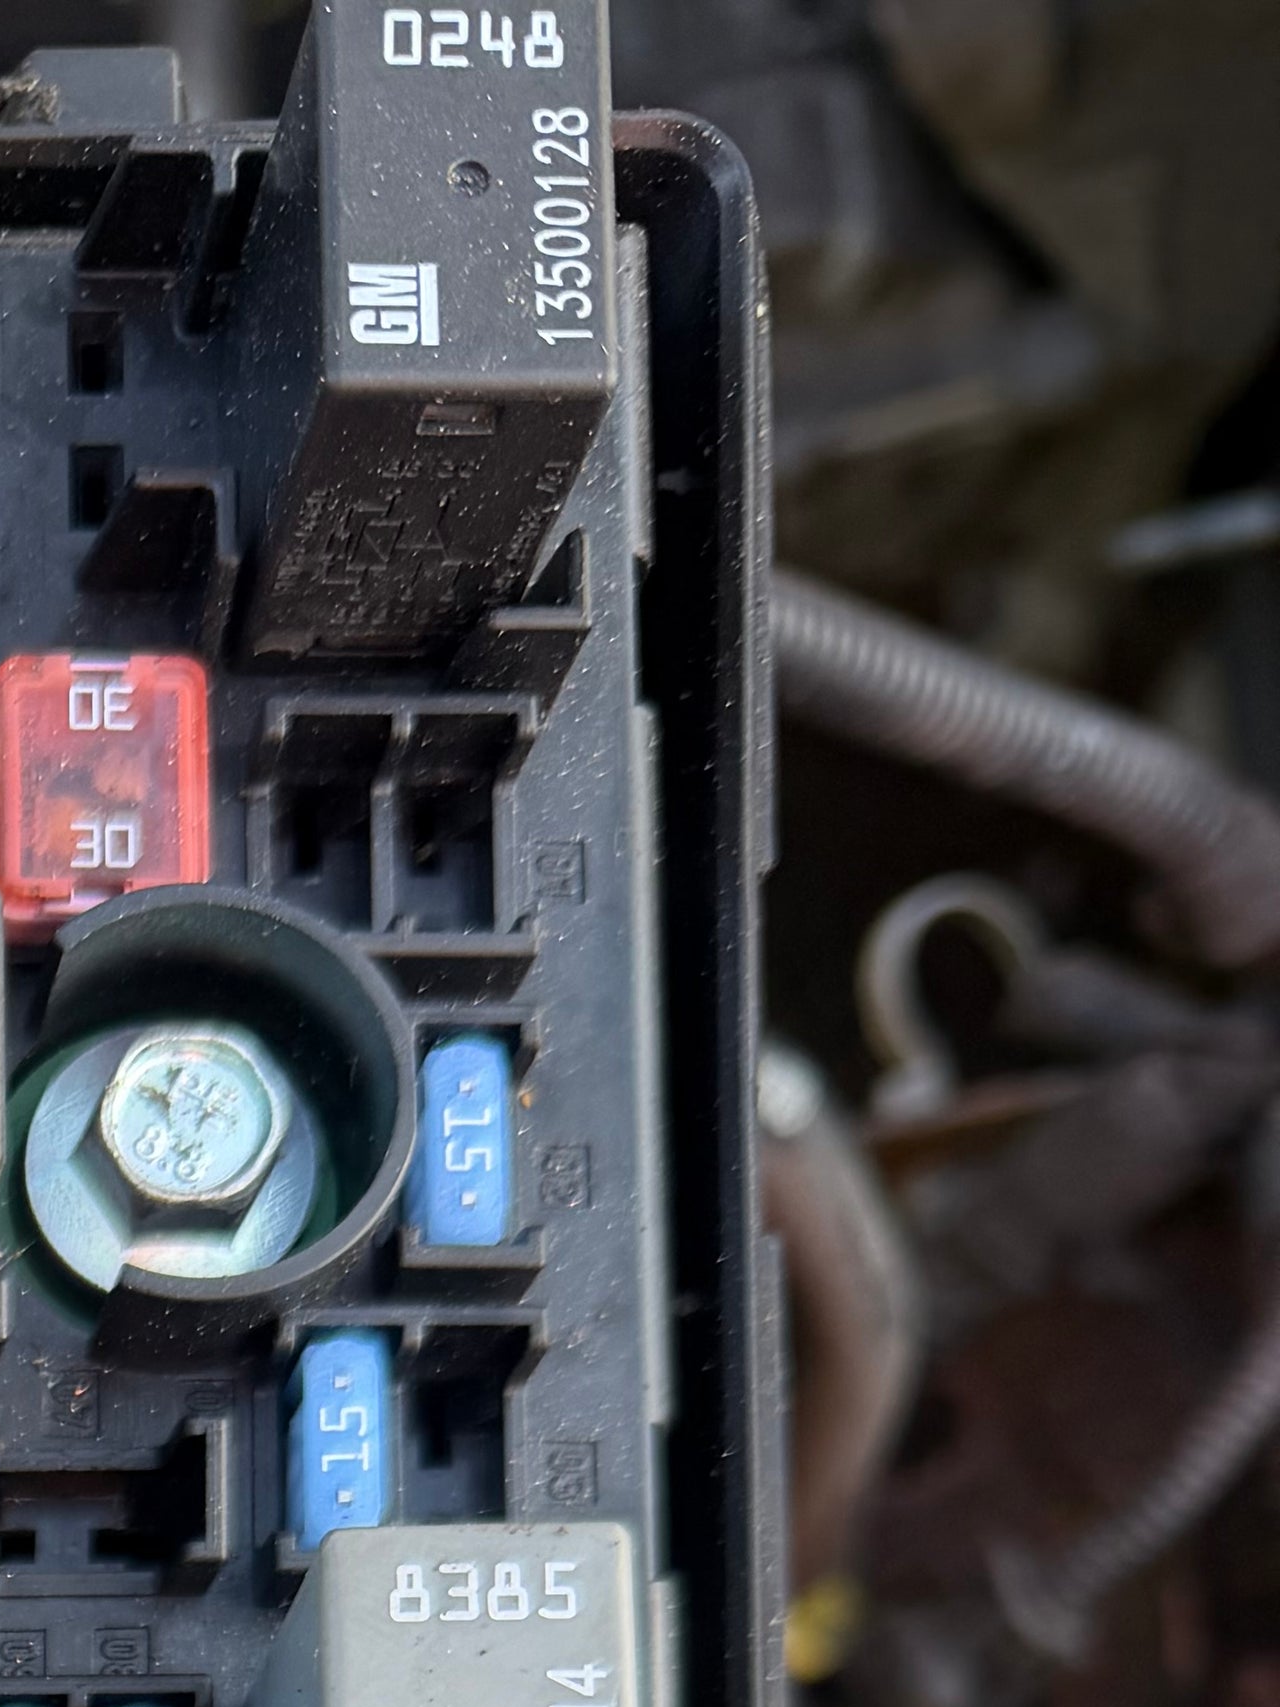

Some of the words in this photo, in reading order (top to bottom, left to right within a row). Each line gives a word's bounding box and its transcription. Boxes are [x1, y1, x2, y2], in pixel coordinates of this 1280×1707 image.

[384, 11, 563, 67] 0248
[533, 108, 592, 346] 13500128
[349, 264, 419, 345] GM
[70, 683, 135, 731] 30
[70, 820, 137, 869] 30
[444, 1107, 491, 1172] 15
[324, 1406, 370, 1473] 15
[390, 1564, 578, 1624] 8385
